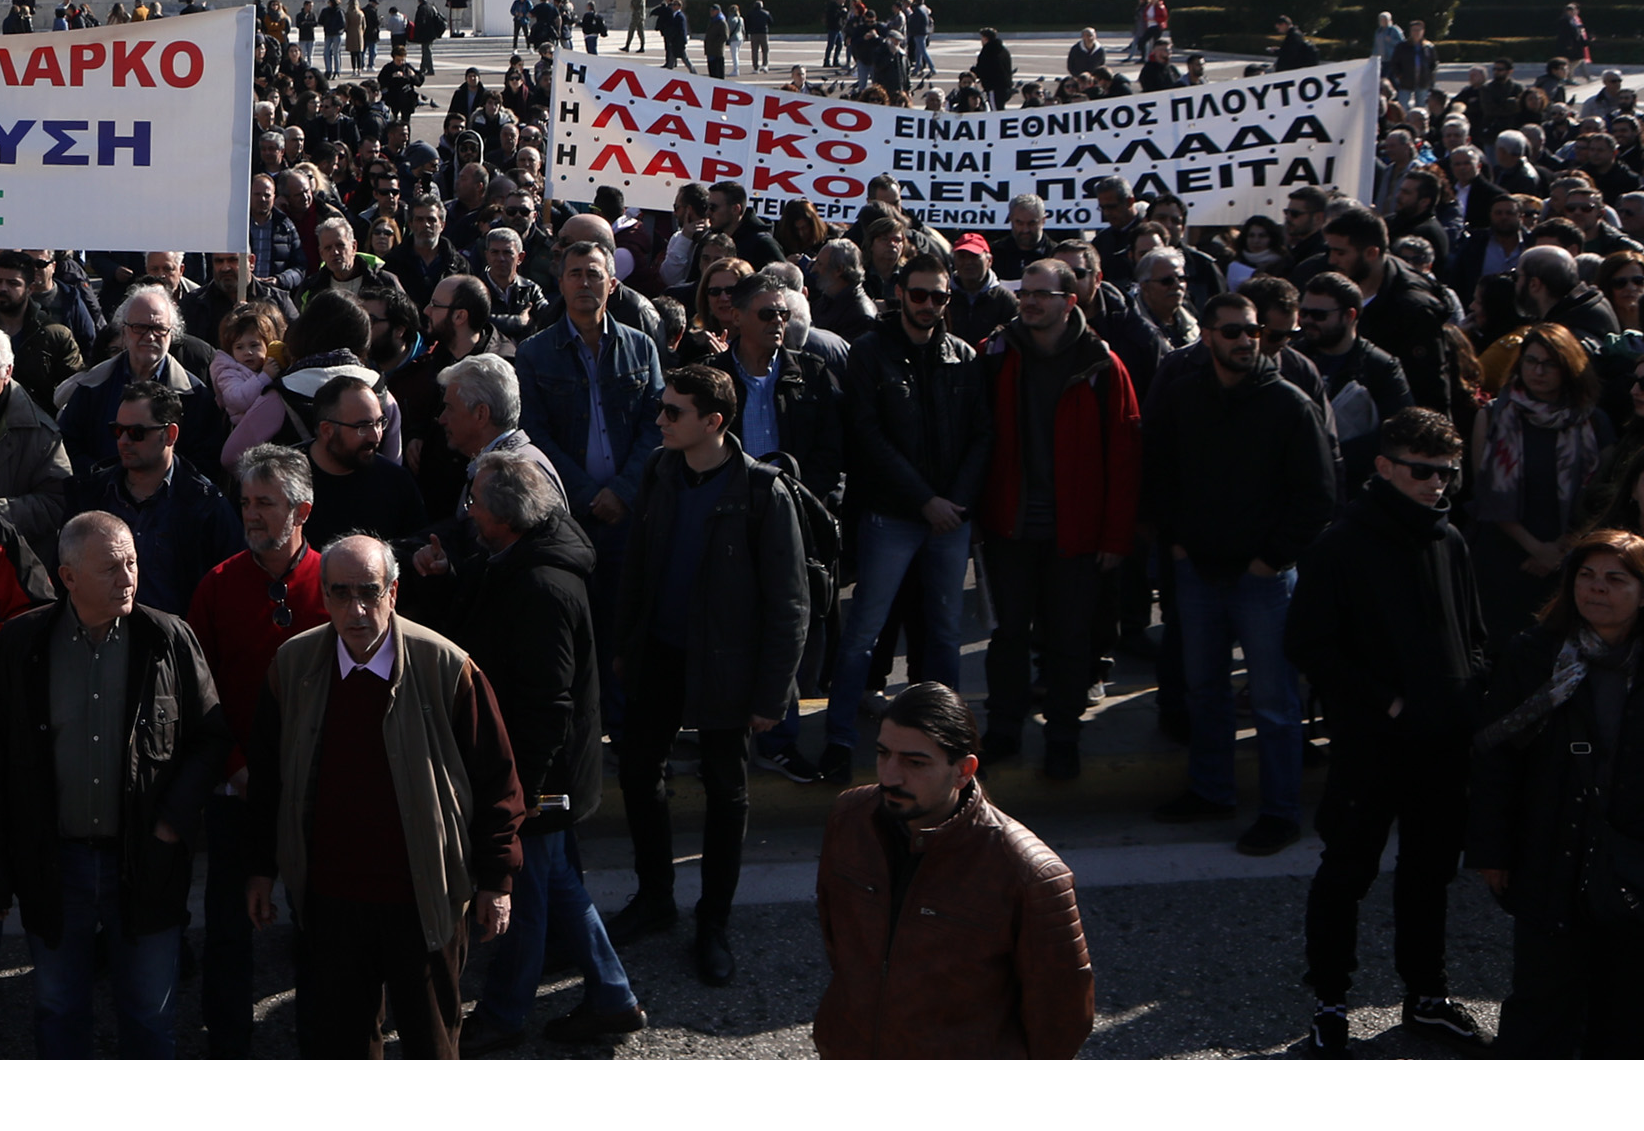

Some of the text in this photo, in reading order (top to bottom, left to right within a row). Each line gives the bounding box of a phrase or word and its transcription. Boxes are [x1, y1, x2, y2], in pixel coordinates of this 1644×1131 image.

[559, 101, 1332, 172] Η ΛΑΡΚΟ ΕΙΝΑΙ ΕΛΛΑΔΑ
[565, 62, 1349, 142] Η ΛΑΡΚΟ ΕΙΝΑΙ ΕΘΝΙΚΟΣ ΠΛΟΥΤΟΣ
[556, 143, 577, 166] Η
[587, 143, 865, 199] ΛΑΡΚΟ
[897, 179, 1010, 203] ΔΕΝ
